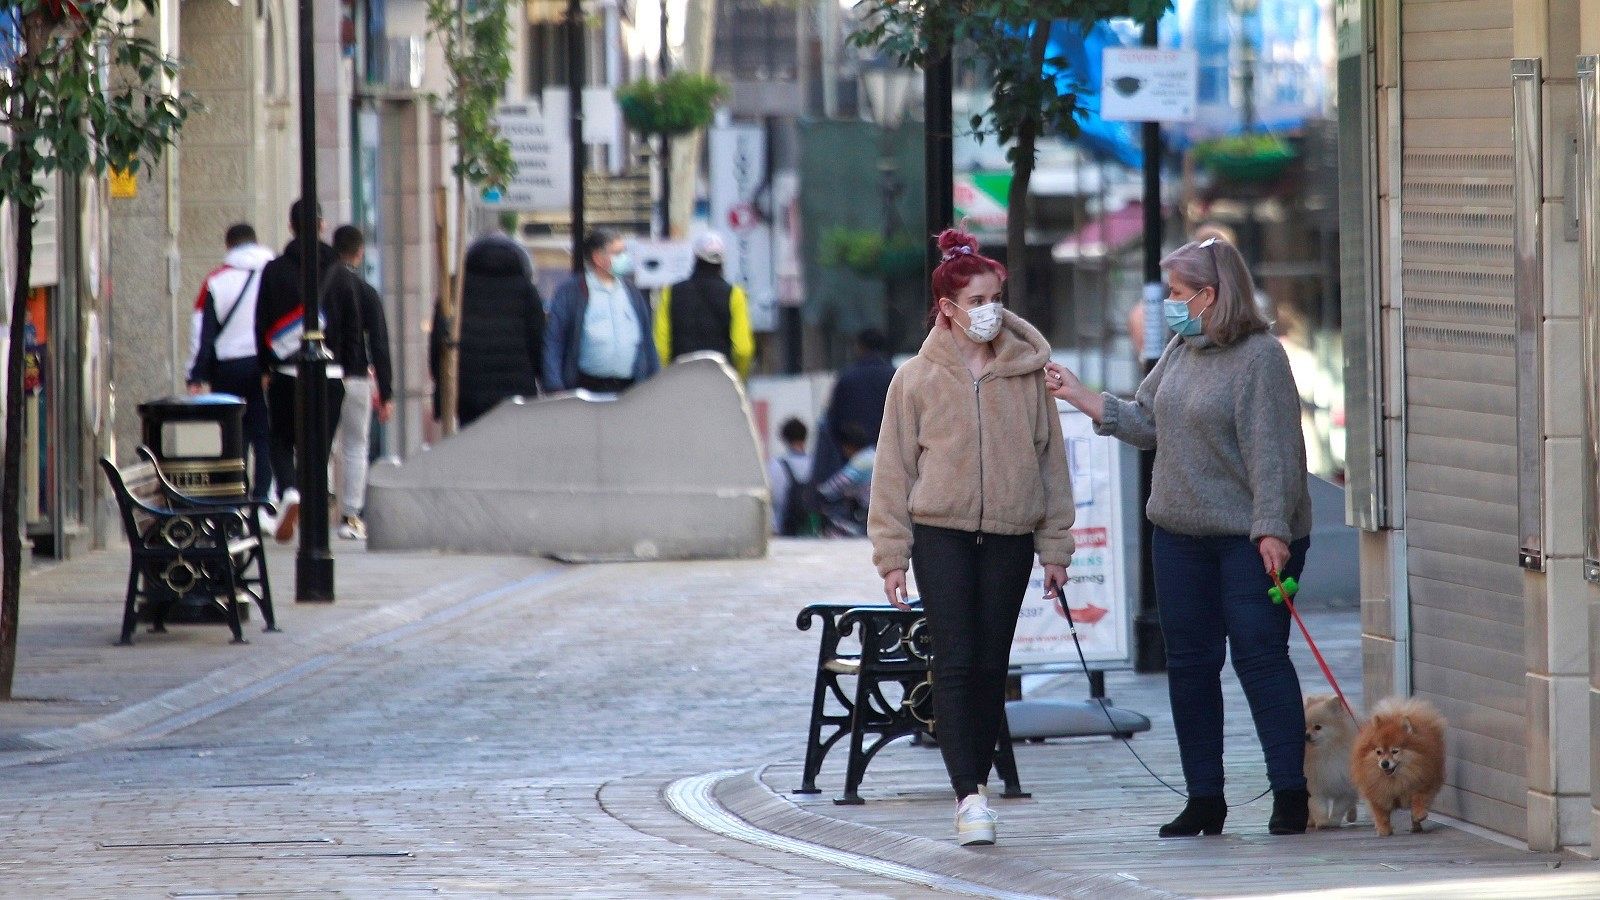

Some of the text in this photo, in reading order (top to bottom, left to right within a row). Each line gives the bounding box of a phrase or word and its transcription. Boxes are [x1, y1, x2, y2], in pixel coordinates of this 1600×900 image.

[168, 471, 211, 487] ITTER
[1071, 555, 1104, 567] MENS
[1072, 574, 1105, 585] smeg
